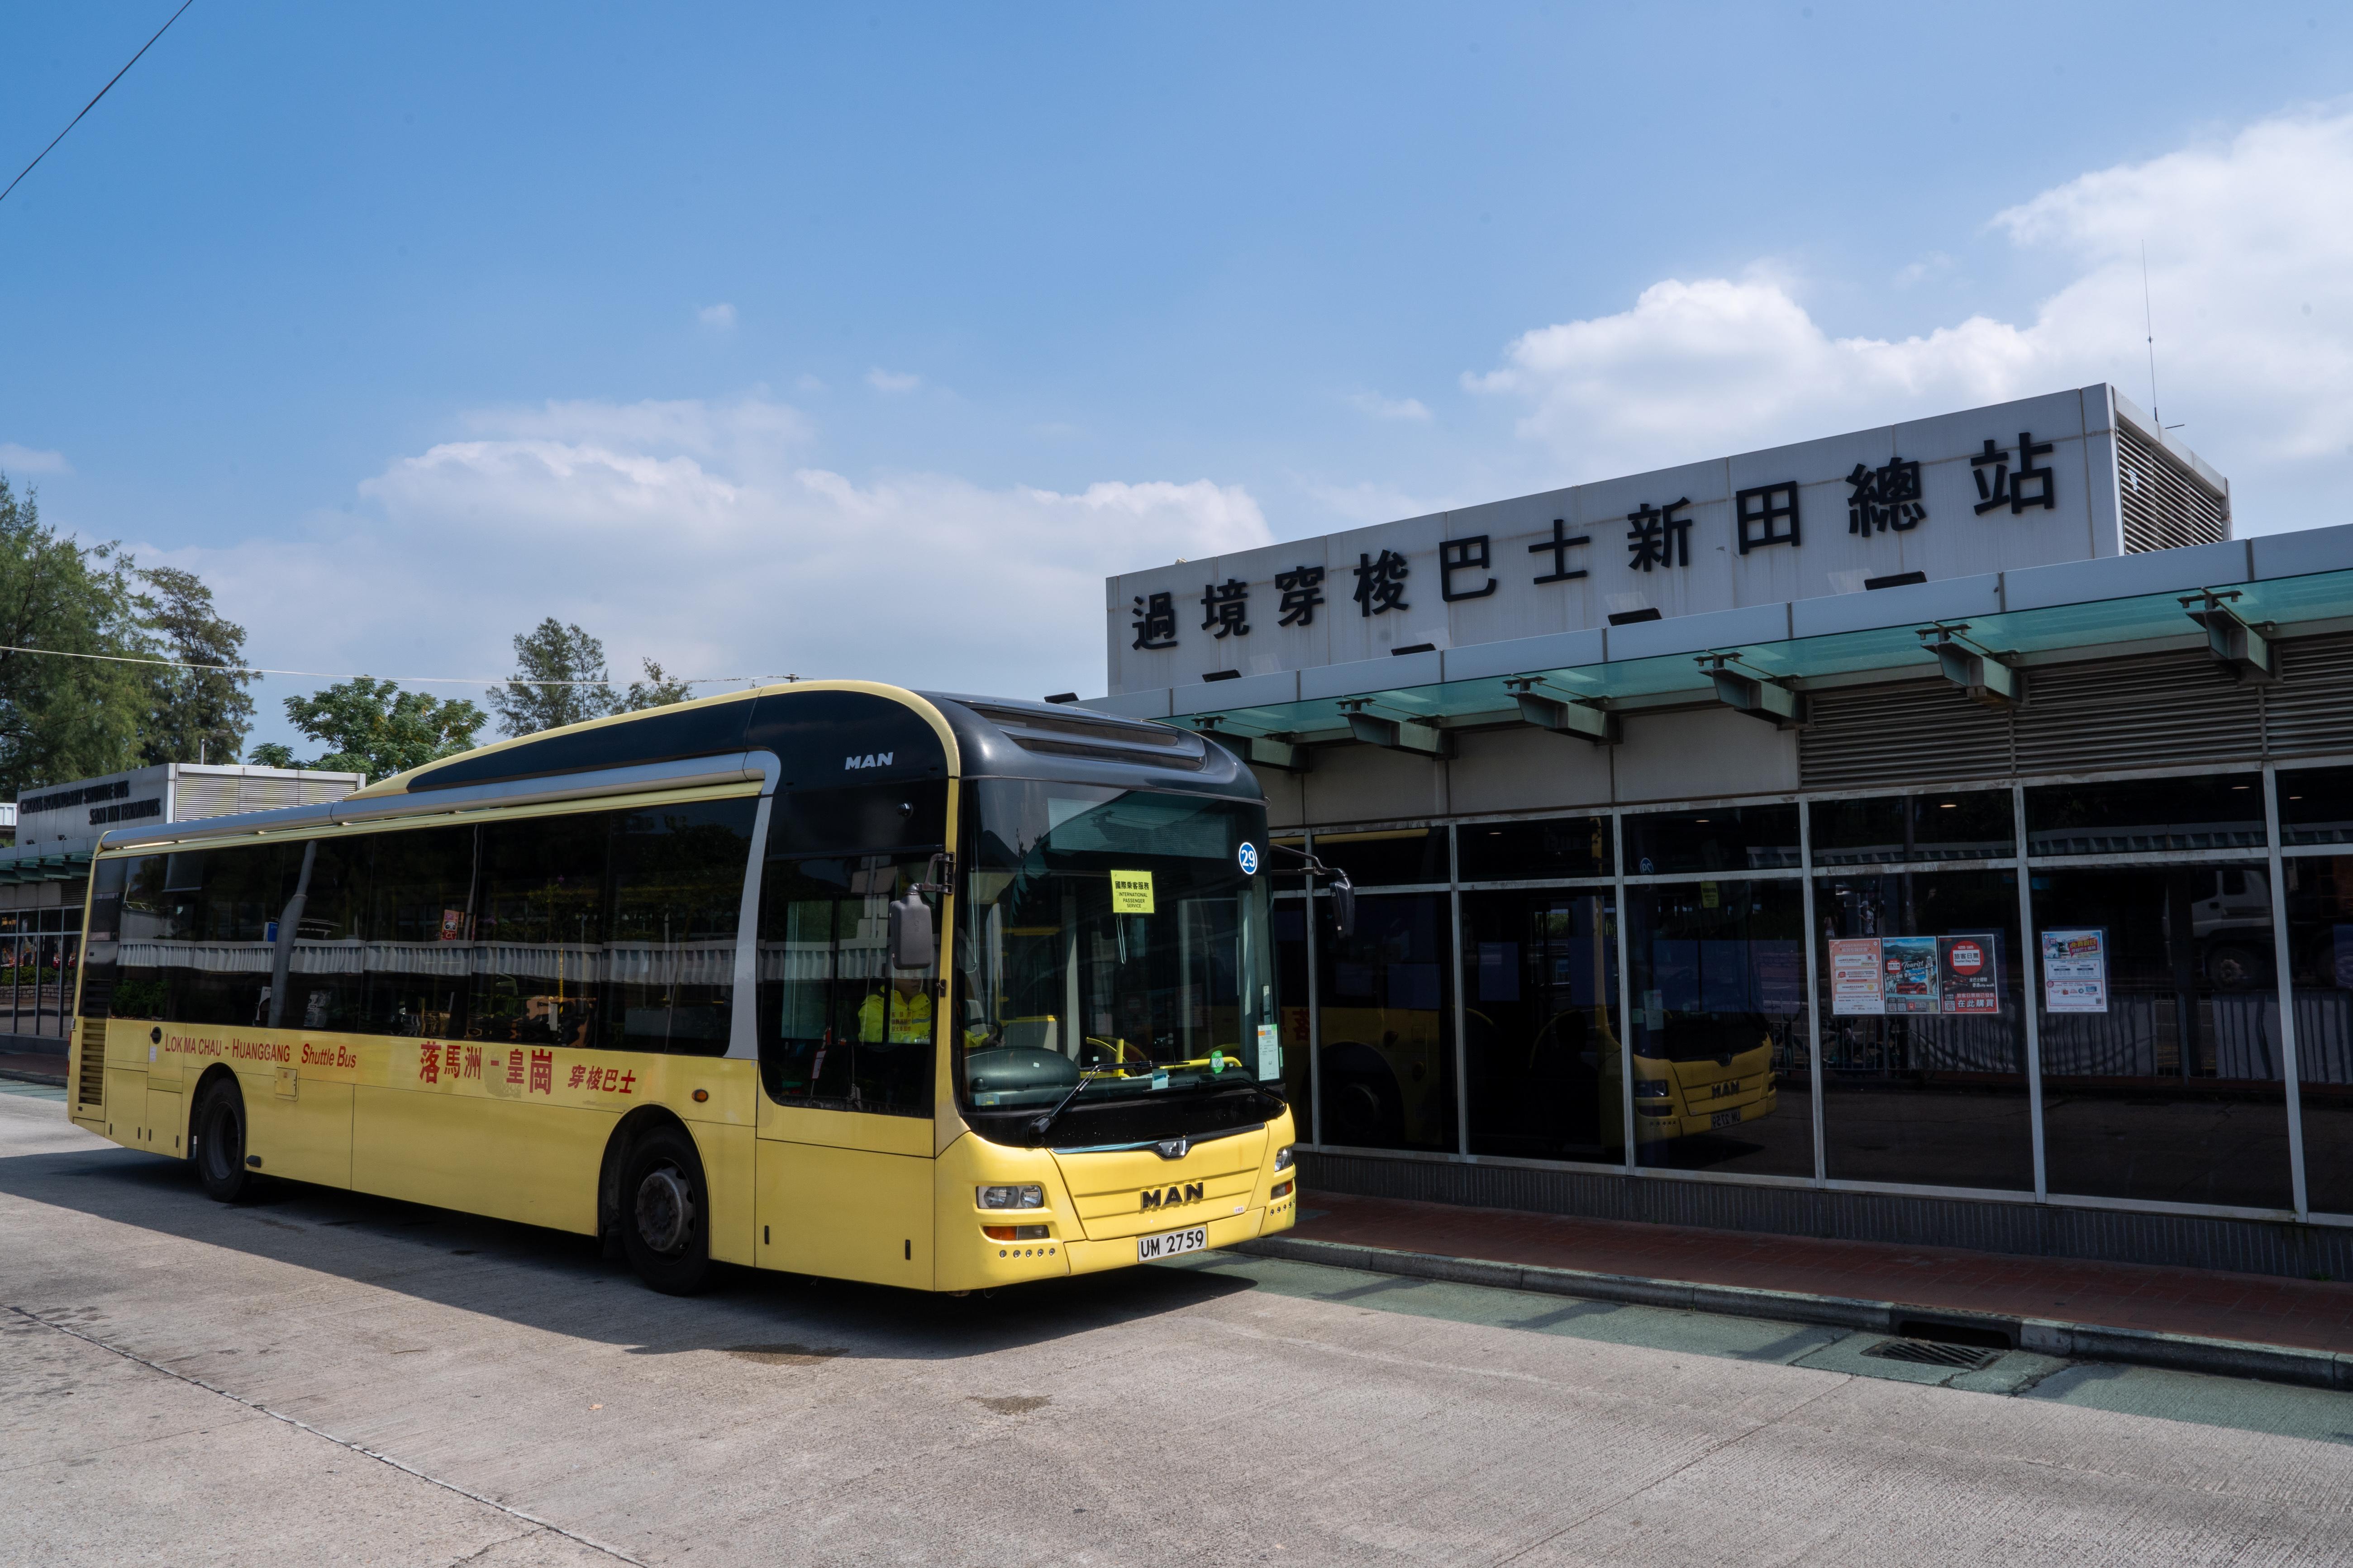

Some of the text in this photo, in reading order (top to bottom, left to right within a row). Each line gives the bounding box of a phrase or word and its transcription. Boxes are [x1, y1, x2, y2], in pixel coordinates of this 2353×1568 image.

[1132, 432, 2055, 650] 過境穿梭巴士新田總站
[845, 752, 894, 770] MAN
[20, 796, 43, 814] CROSS
[43, 789, 83, 810] BOUNDARY
[113, 780, 129, 798] BUS
[89, 798, 161, 825] SAN TIN TERMINUS
[1241, 849, 1255, 867] 29
[1115, 881, 1149, 890] 國際乘客服務
[1902, 960, 1924, 970] Tourist
[1958, 999, 1994, 1007] 在此購買
[165, 1033, 183, 1053] LOK
[184, 1037, 196, 1054] MA
[199, 1038, 222, 1056] CHAU
[232, 1038, 290, 1062] HUANGGANG
[301, 1043, 334, 1066] Shuttle
[337, 1046, 357, 1068] Bus
[419, 1041, 482, 1084] 落馬洲
[506, 1049, 553, 1095] 皇崗
[567, 1064, 636, 1094] 穿梭巴士
[1142, 1182, 1204, 1209] MAN
[1140, 1230, 1204, 1259] UM 2759
